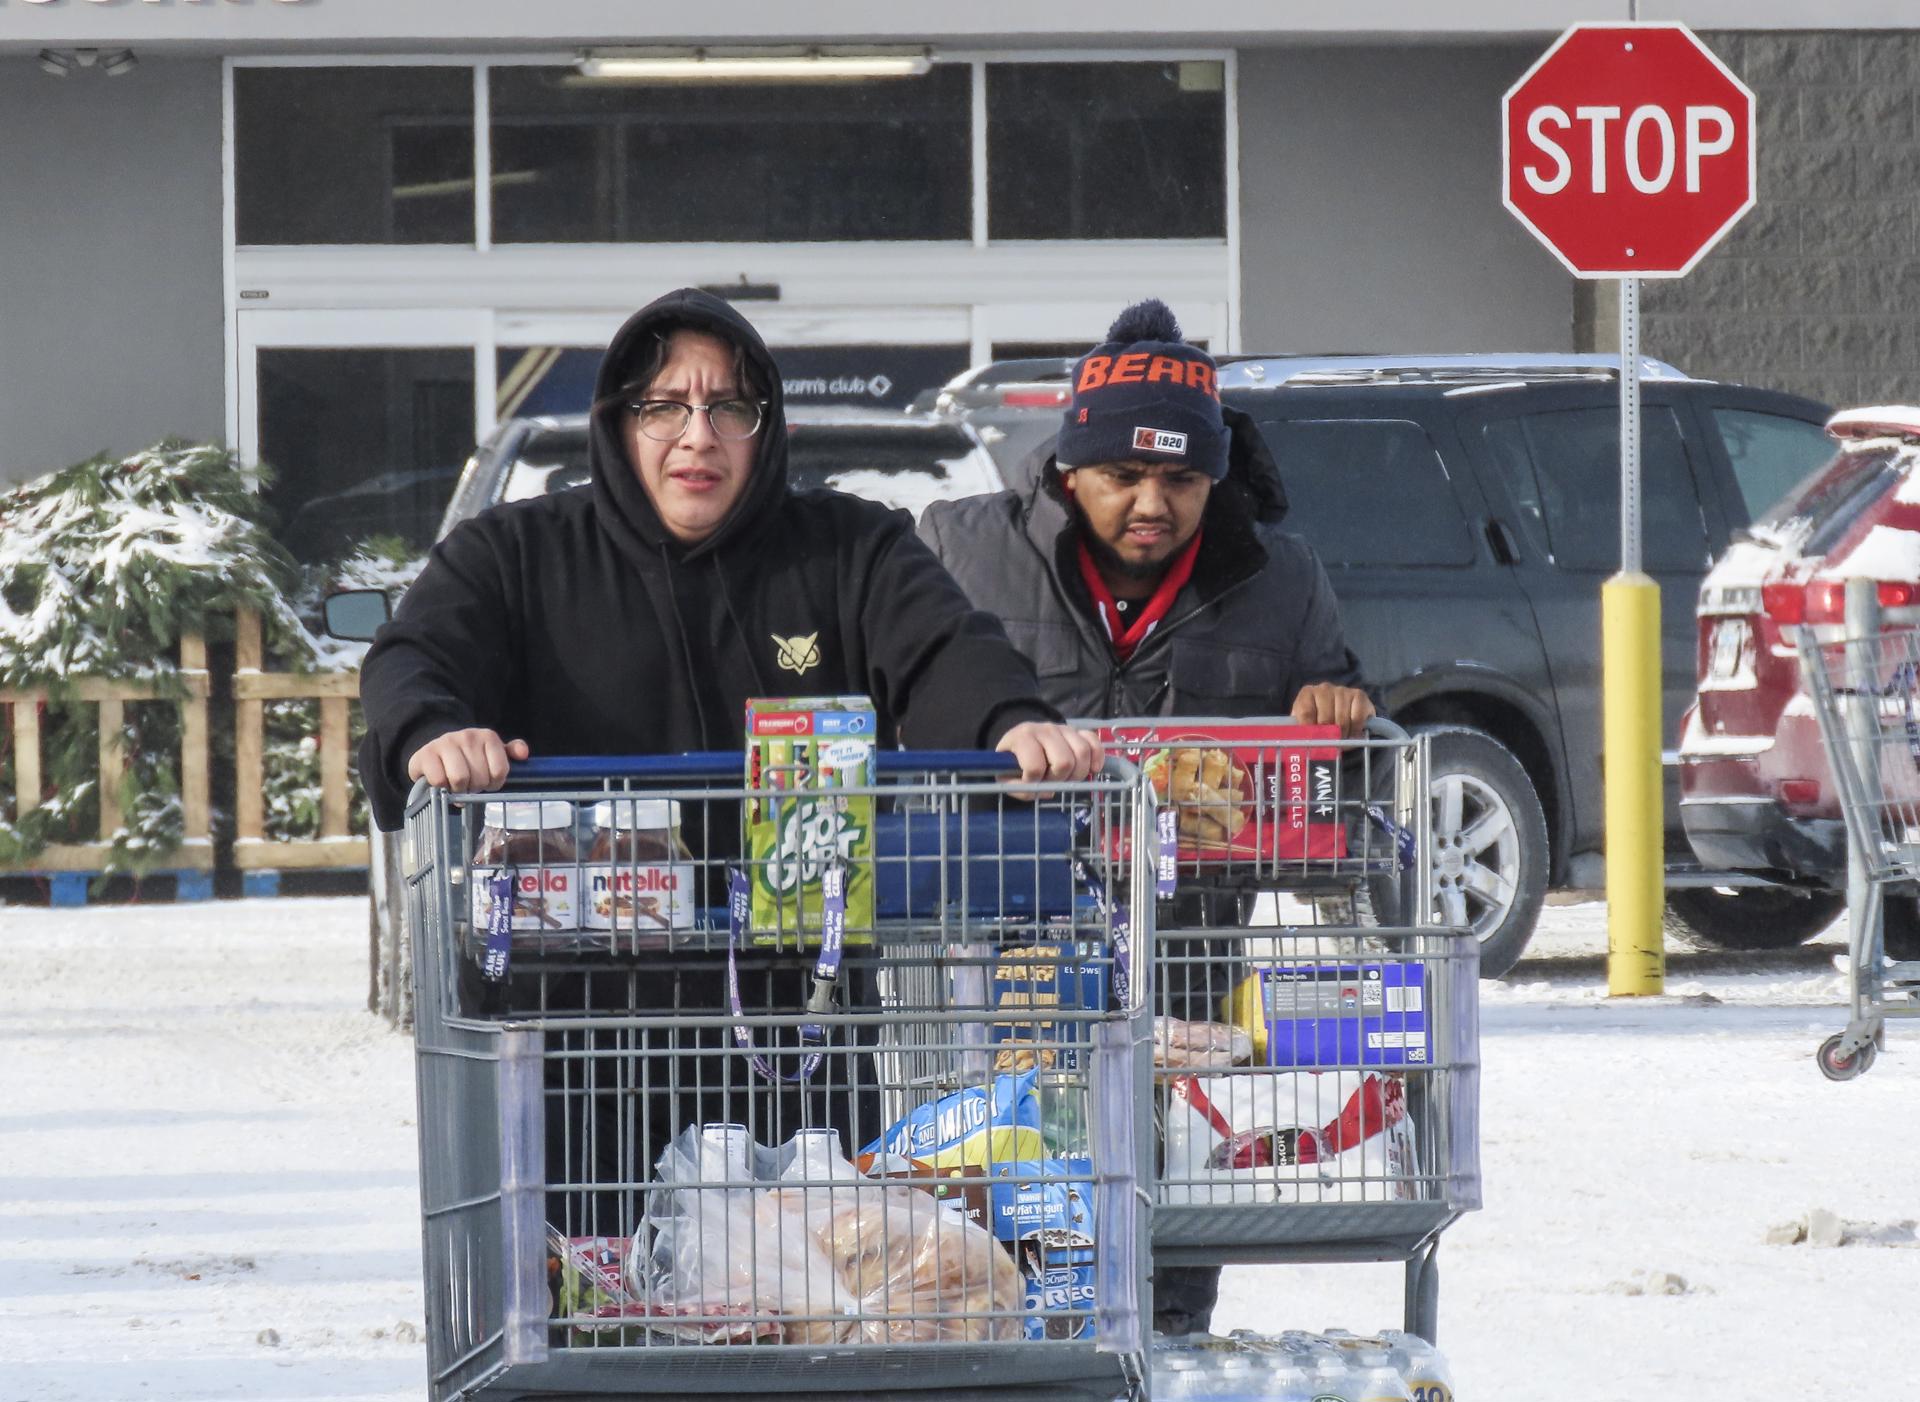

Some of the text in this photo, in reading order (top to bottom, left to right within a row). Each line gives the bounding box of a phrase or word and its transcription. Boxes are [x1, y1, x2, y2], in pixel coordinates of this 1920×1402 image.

[1523, 104, 1735, 195] STOP
[829, 376, 865, 394] club
[1156, 435, 1183, 450] 1920
[1290, 754, 1302, 784] EGG
[1063, 966, 1100, 975] ELOWS
[919, 1127, 935, 1145] AND
